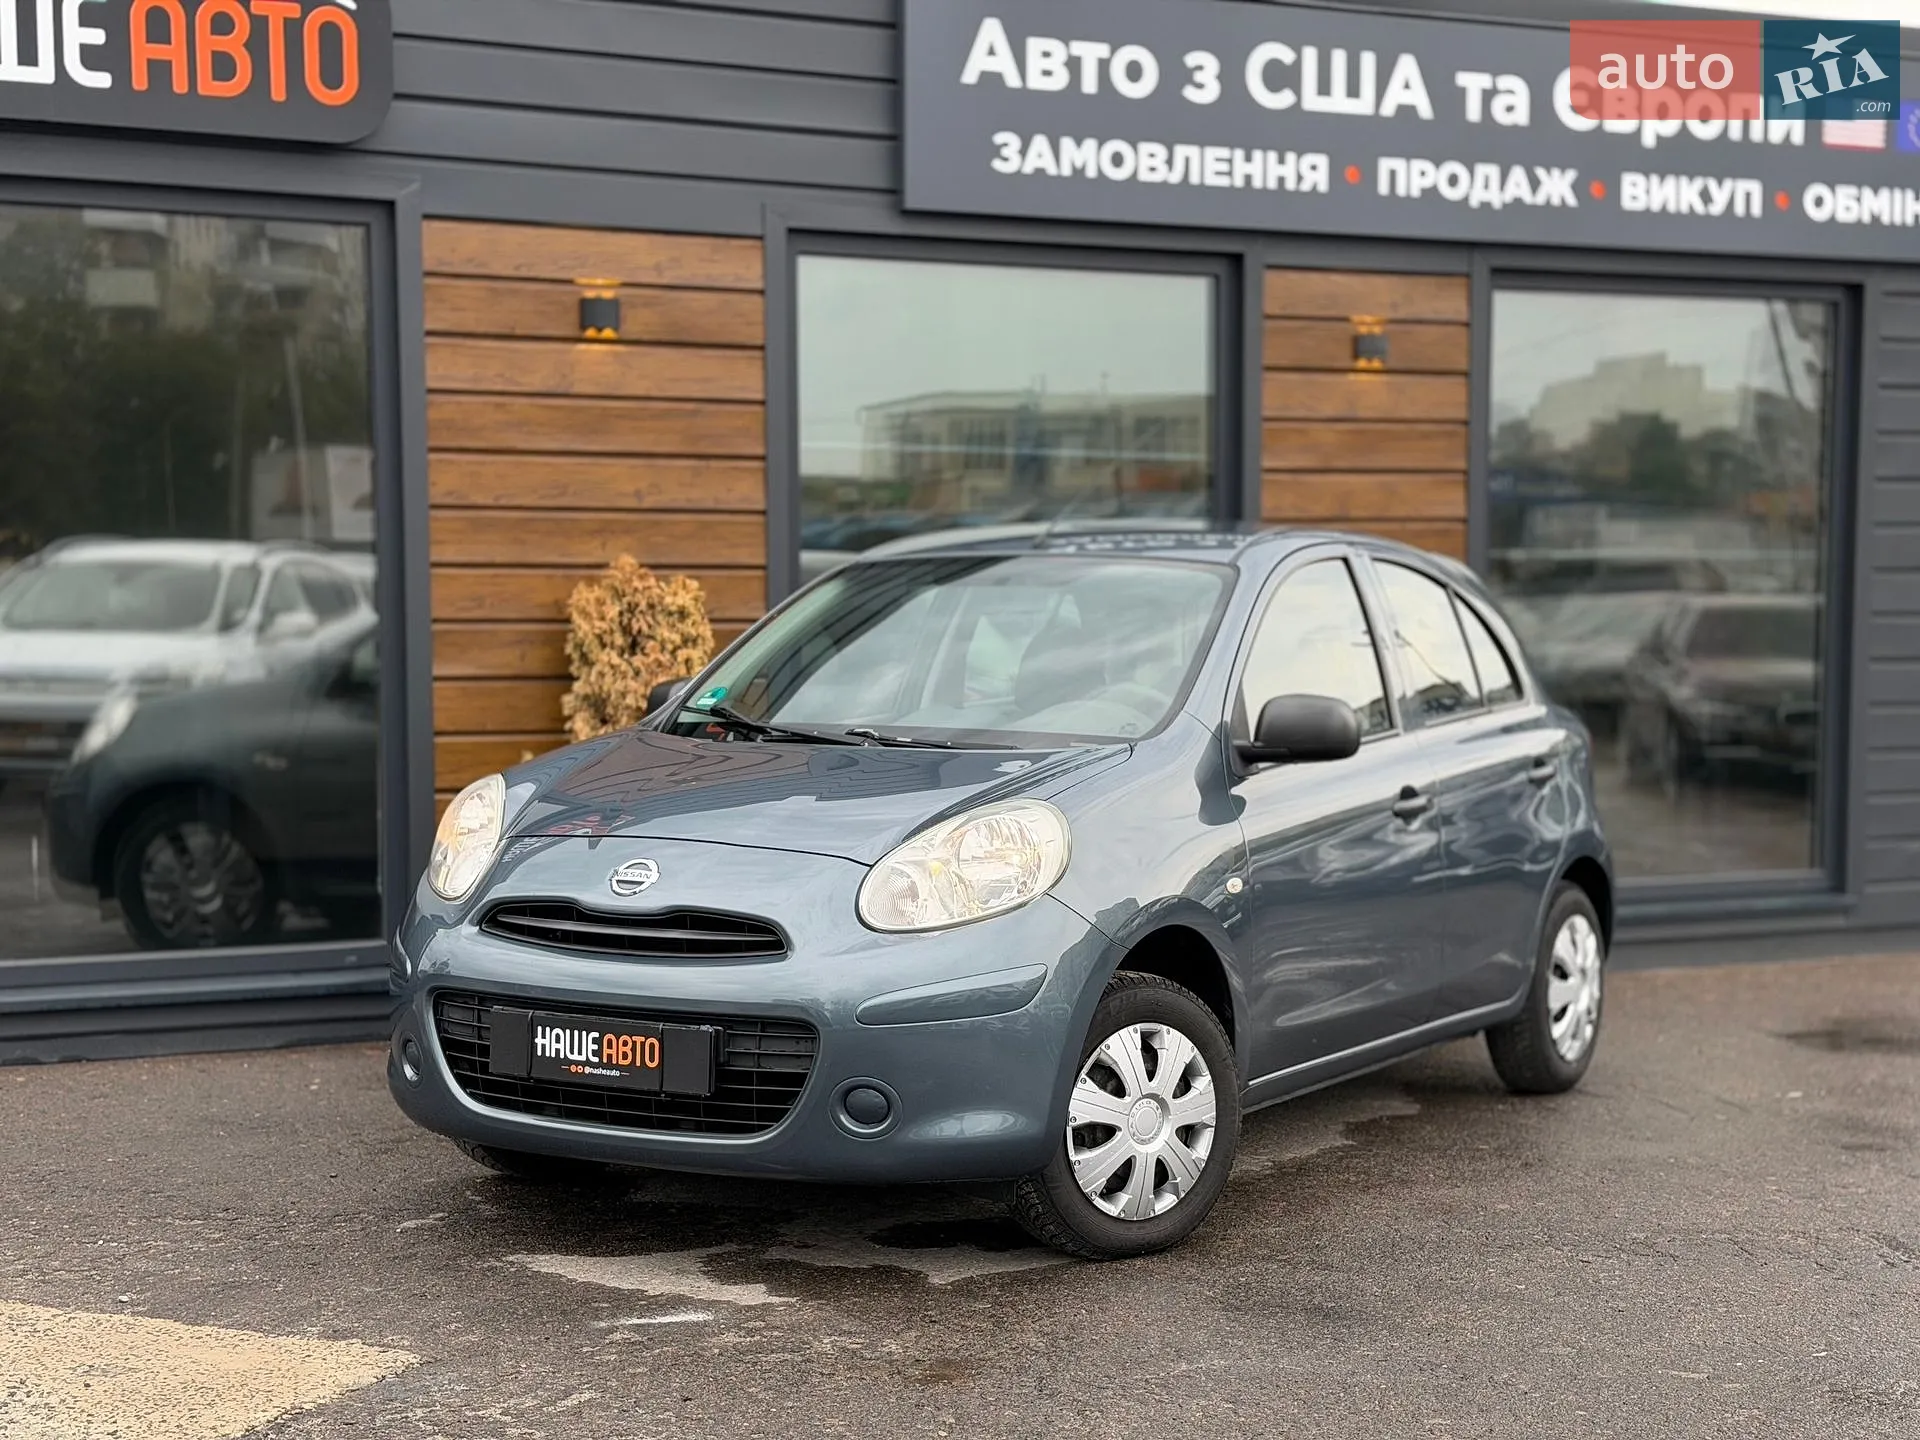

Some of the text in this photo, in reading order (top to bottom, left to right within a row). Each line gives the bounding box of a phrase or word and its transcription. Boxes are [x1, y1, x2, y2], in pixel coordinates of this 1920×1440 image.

[129, 0, 359, 106] АВТО
[1244, 40, 1434, 120] США
[1455, 70, 1531, 126] та
[990, 130, 1330, 193] ЗАМОВЛЕННЯ
[1377, 156, 1579, 210] ПРОДАЖ
[1620, 172, 1763, 218] ВИКУП
[612, 870, 652, 879] NISSAN
[534, 1025, 660, 1068] НАШЕ АВТО
[584, 1065, 620, 1077] @nasheauto
